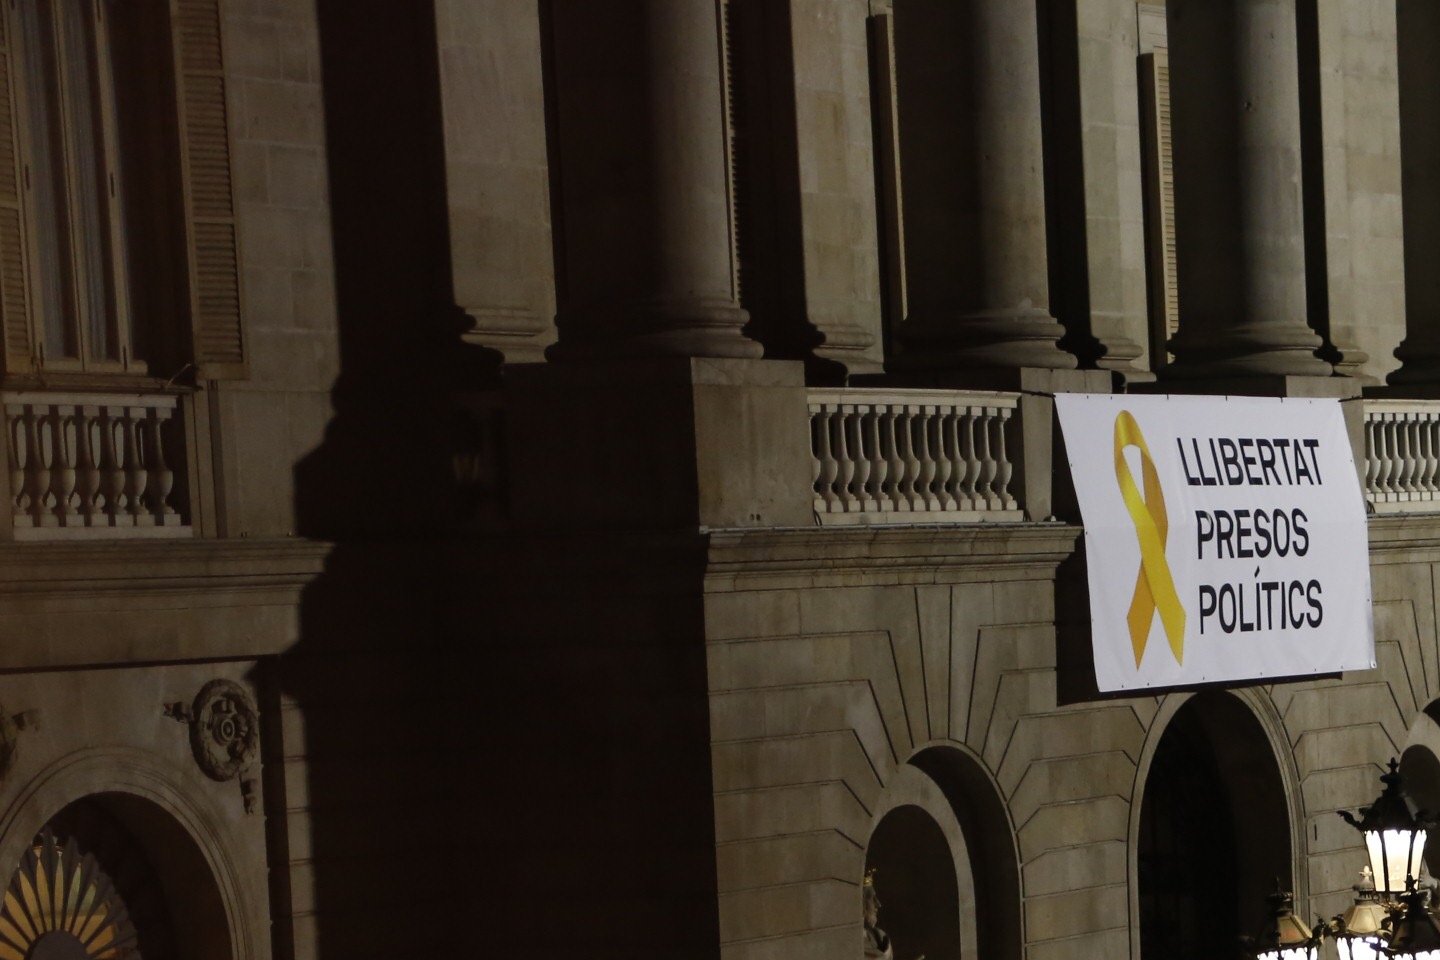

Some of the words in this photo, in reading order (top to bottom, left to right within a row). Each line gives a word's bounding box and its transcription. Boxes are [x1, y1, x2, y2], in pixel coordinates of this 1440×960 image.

[1176, 437, 1323, 486] LLIBERTAT
[1195, 508, 1310, 560] PRESOS
[1199, 566, 1323, 634] POLÍTICS
